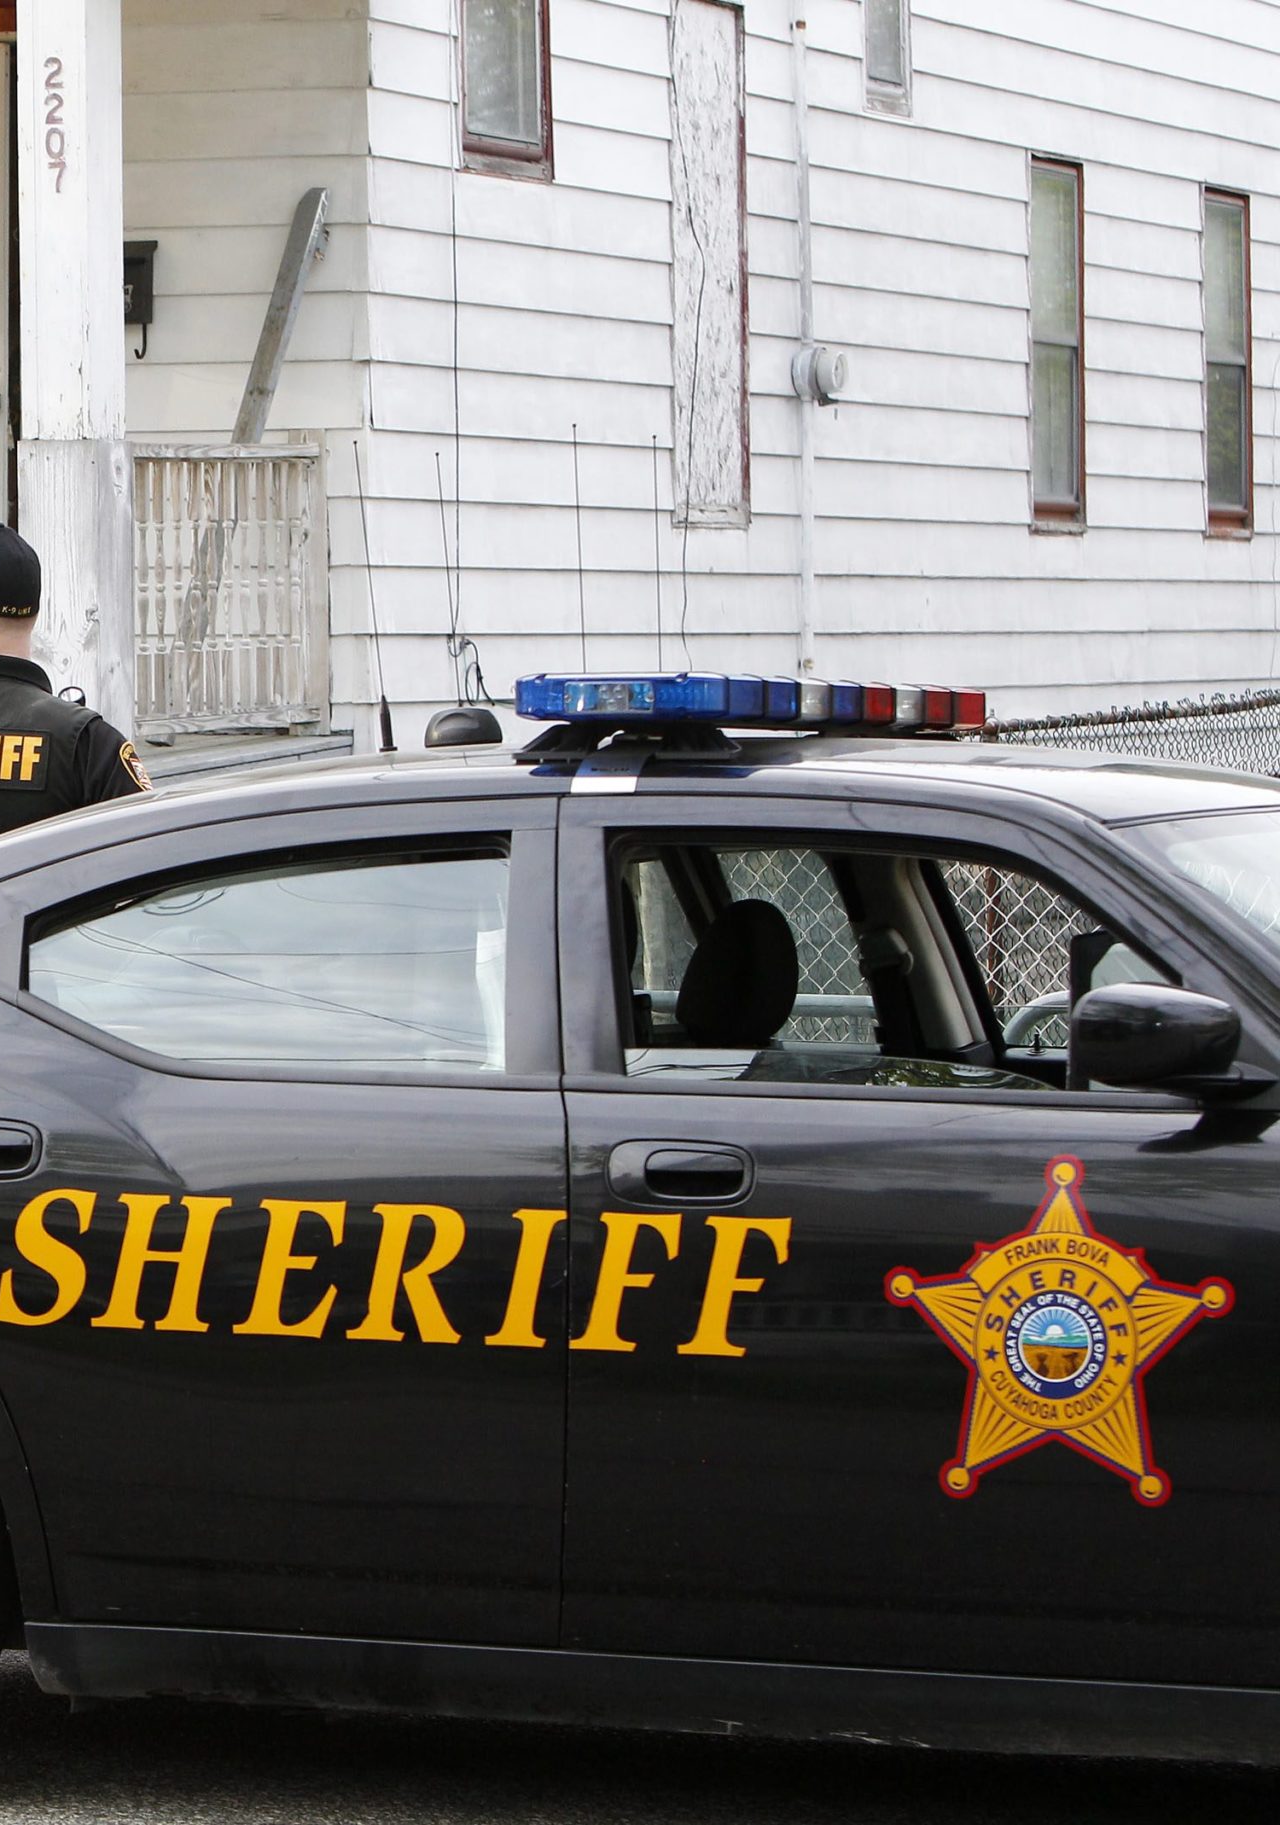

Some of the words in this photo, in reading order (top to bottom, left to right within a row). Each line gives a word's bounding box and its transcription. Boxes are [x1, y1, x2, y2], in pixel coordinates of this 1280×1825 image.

[43, 56, 67, 193] 2207
[1004, 1238, 1060, 1266] FRANK
[1066, 1239, 1110, 1267] BOVA
[984, 1269, 1128, 1337] SHERIFF
[1037, 1293, 1054, 1306] OF
[1055, 1293, 1080, 1309] THE
[1010, 1302, 1037, 1329] SEAL
[1078, 1304, 1104, 1341] STATE
[1006, 1331, 1023, 1372] GREAT
[1093, 1343, 1105, 1362] OF
[1020, 1372, 1042, 1393] THE
[1074, 1362, 1100, 1389] OHIO
[989, 1369, 1059, 1421] CUYAHOGA
[1064, 1374, 1119, 1419] COUNTY
